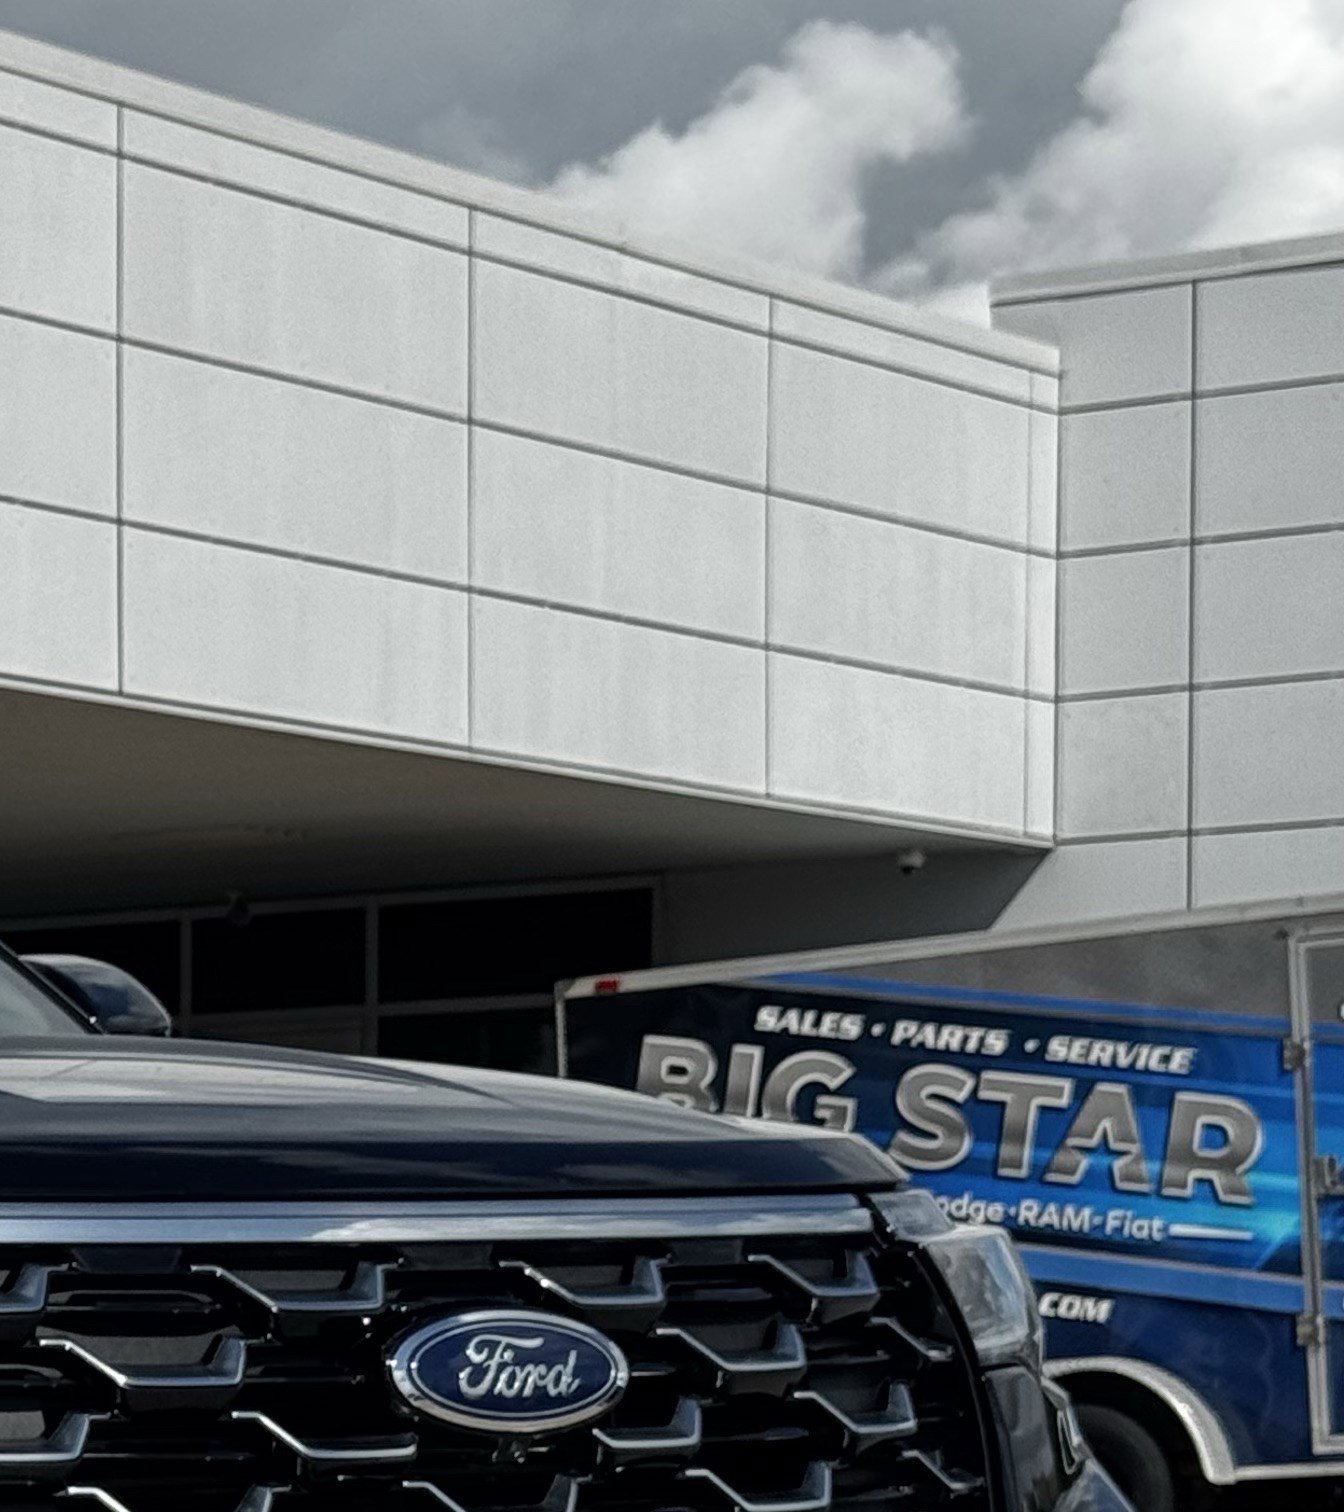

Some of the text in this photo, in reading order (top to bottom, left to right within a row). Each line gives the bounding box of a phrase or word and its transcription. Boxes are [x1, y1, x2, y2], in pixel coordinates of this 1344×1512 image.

[754, 1005, 1198, 1074] SALES PARTS SERVICE
[635, 1034, 1265, 1206] BIG STAR
[936, 1191, 1005, 1224] odge
[459, 1334, 581, 1398] Ford
